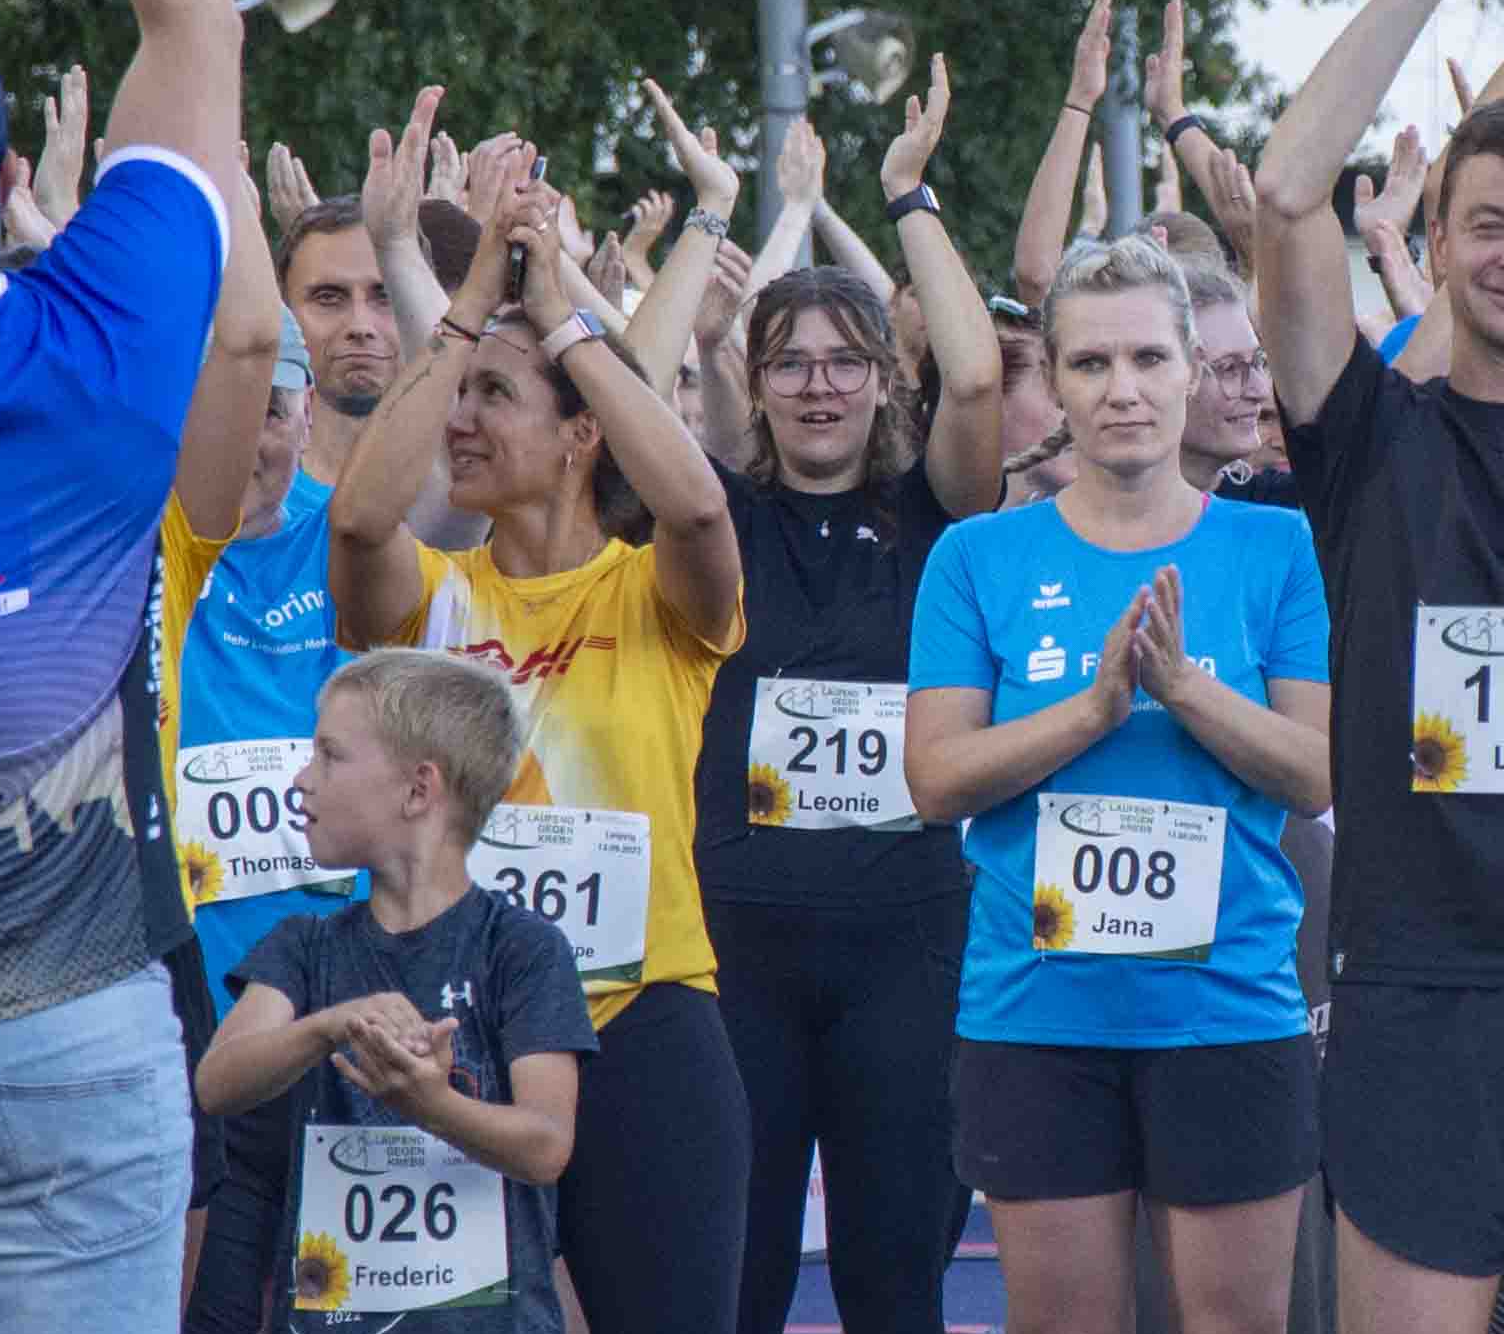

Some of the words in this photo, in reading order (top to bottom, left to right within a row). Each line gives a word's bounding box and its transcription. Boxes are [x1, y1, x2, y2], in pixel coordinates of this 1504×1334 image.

[786, 726, 888, 776] 219
[798, 789, 880, 813] Leonie
[229, 856, 318, 877] Thomas
[1073, 844, 1176, 900] 008
[495, 867, 601, 926] 361
[1092, 911, 1154, 938] Jana
[345, 1182, 457, 1242] 026
[354, 1263, 454, 1287] Frederic
